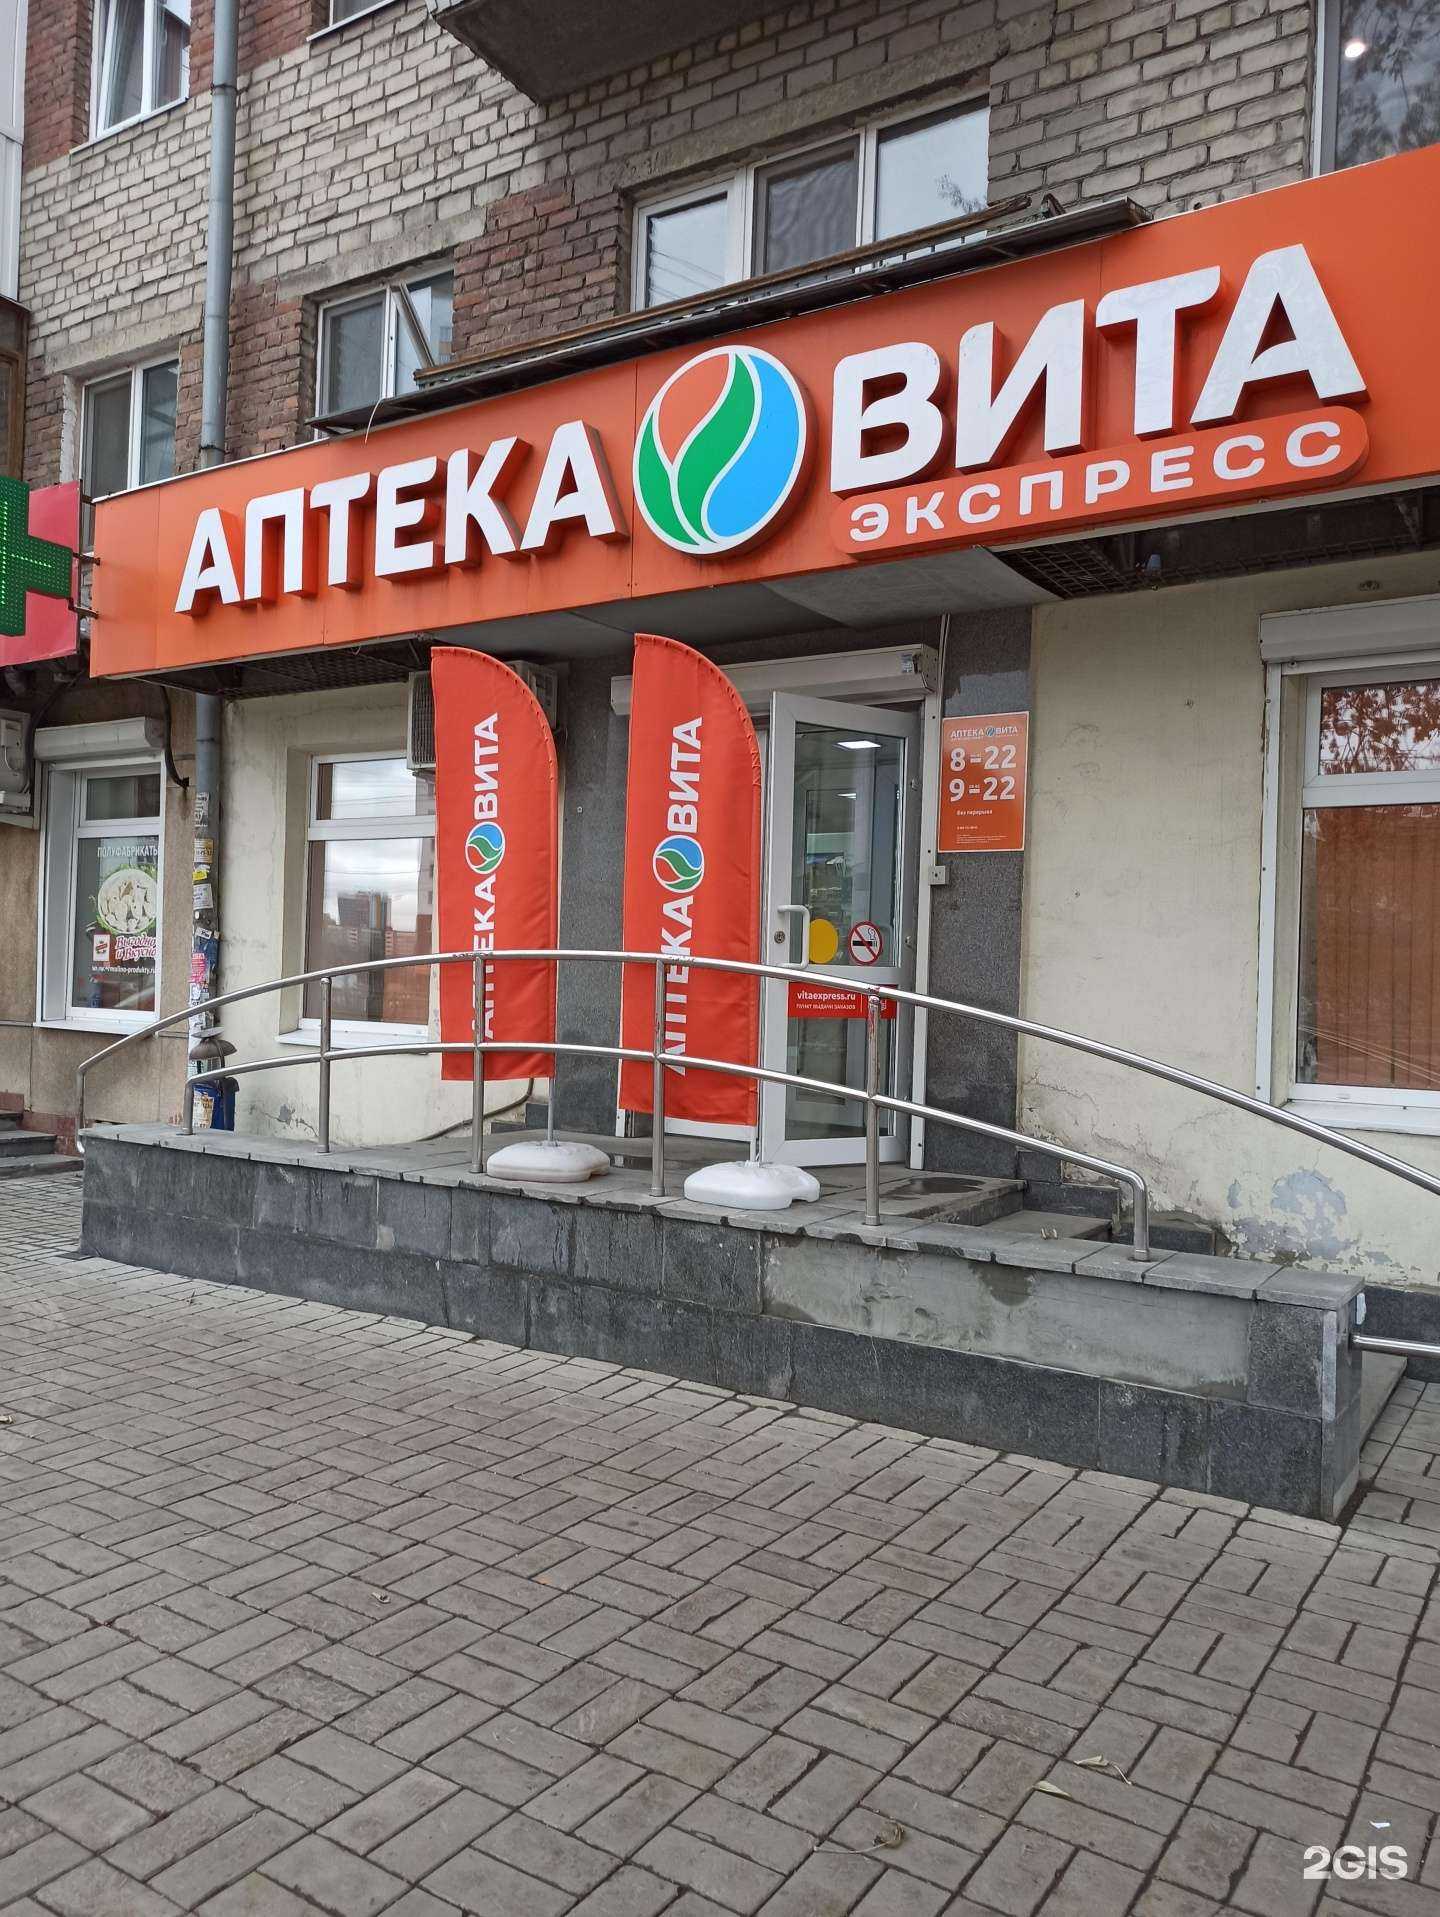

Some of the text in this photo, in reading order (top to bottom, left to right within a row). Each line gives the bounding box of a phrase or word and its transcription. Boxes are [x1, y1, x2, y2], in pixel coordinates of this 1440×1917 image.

[174, 243, 1367, 614] АПТЕКА ВИТА
[849, 421, 1342, 543] ЭКСПРЕСС
[473, 711, 499, 820] ВИТА
[667, 716, 703, 834] ВИТА
[950, 728, 985, 738] АПТЕКА
[995, 726, 1018, 735] ВИТА
[797, 990, 856, 1002] vitaexpress.ru
